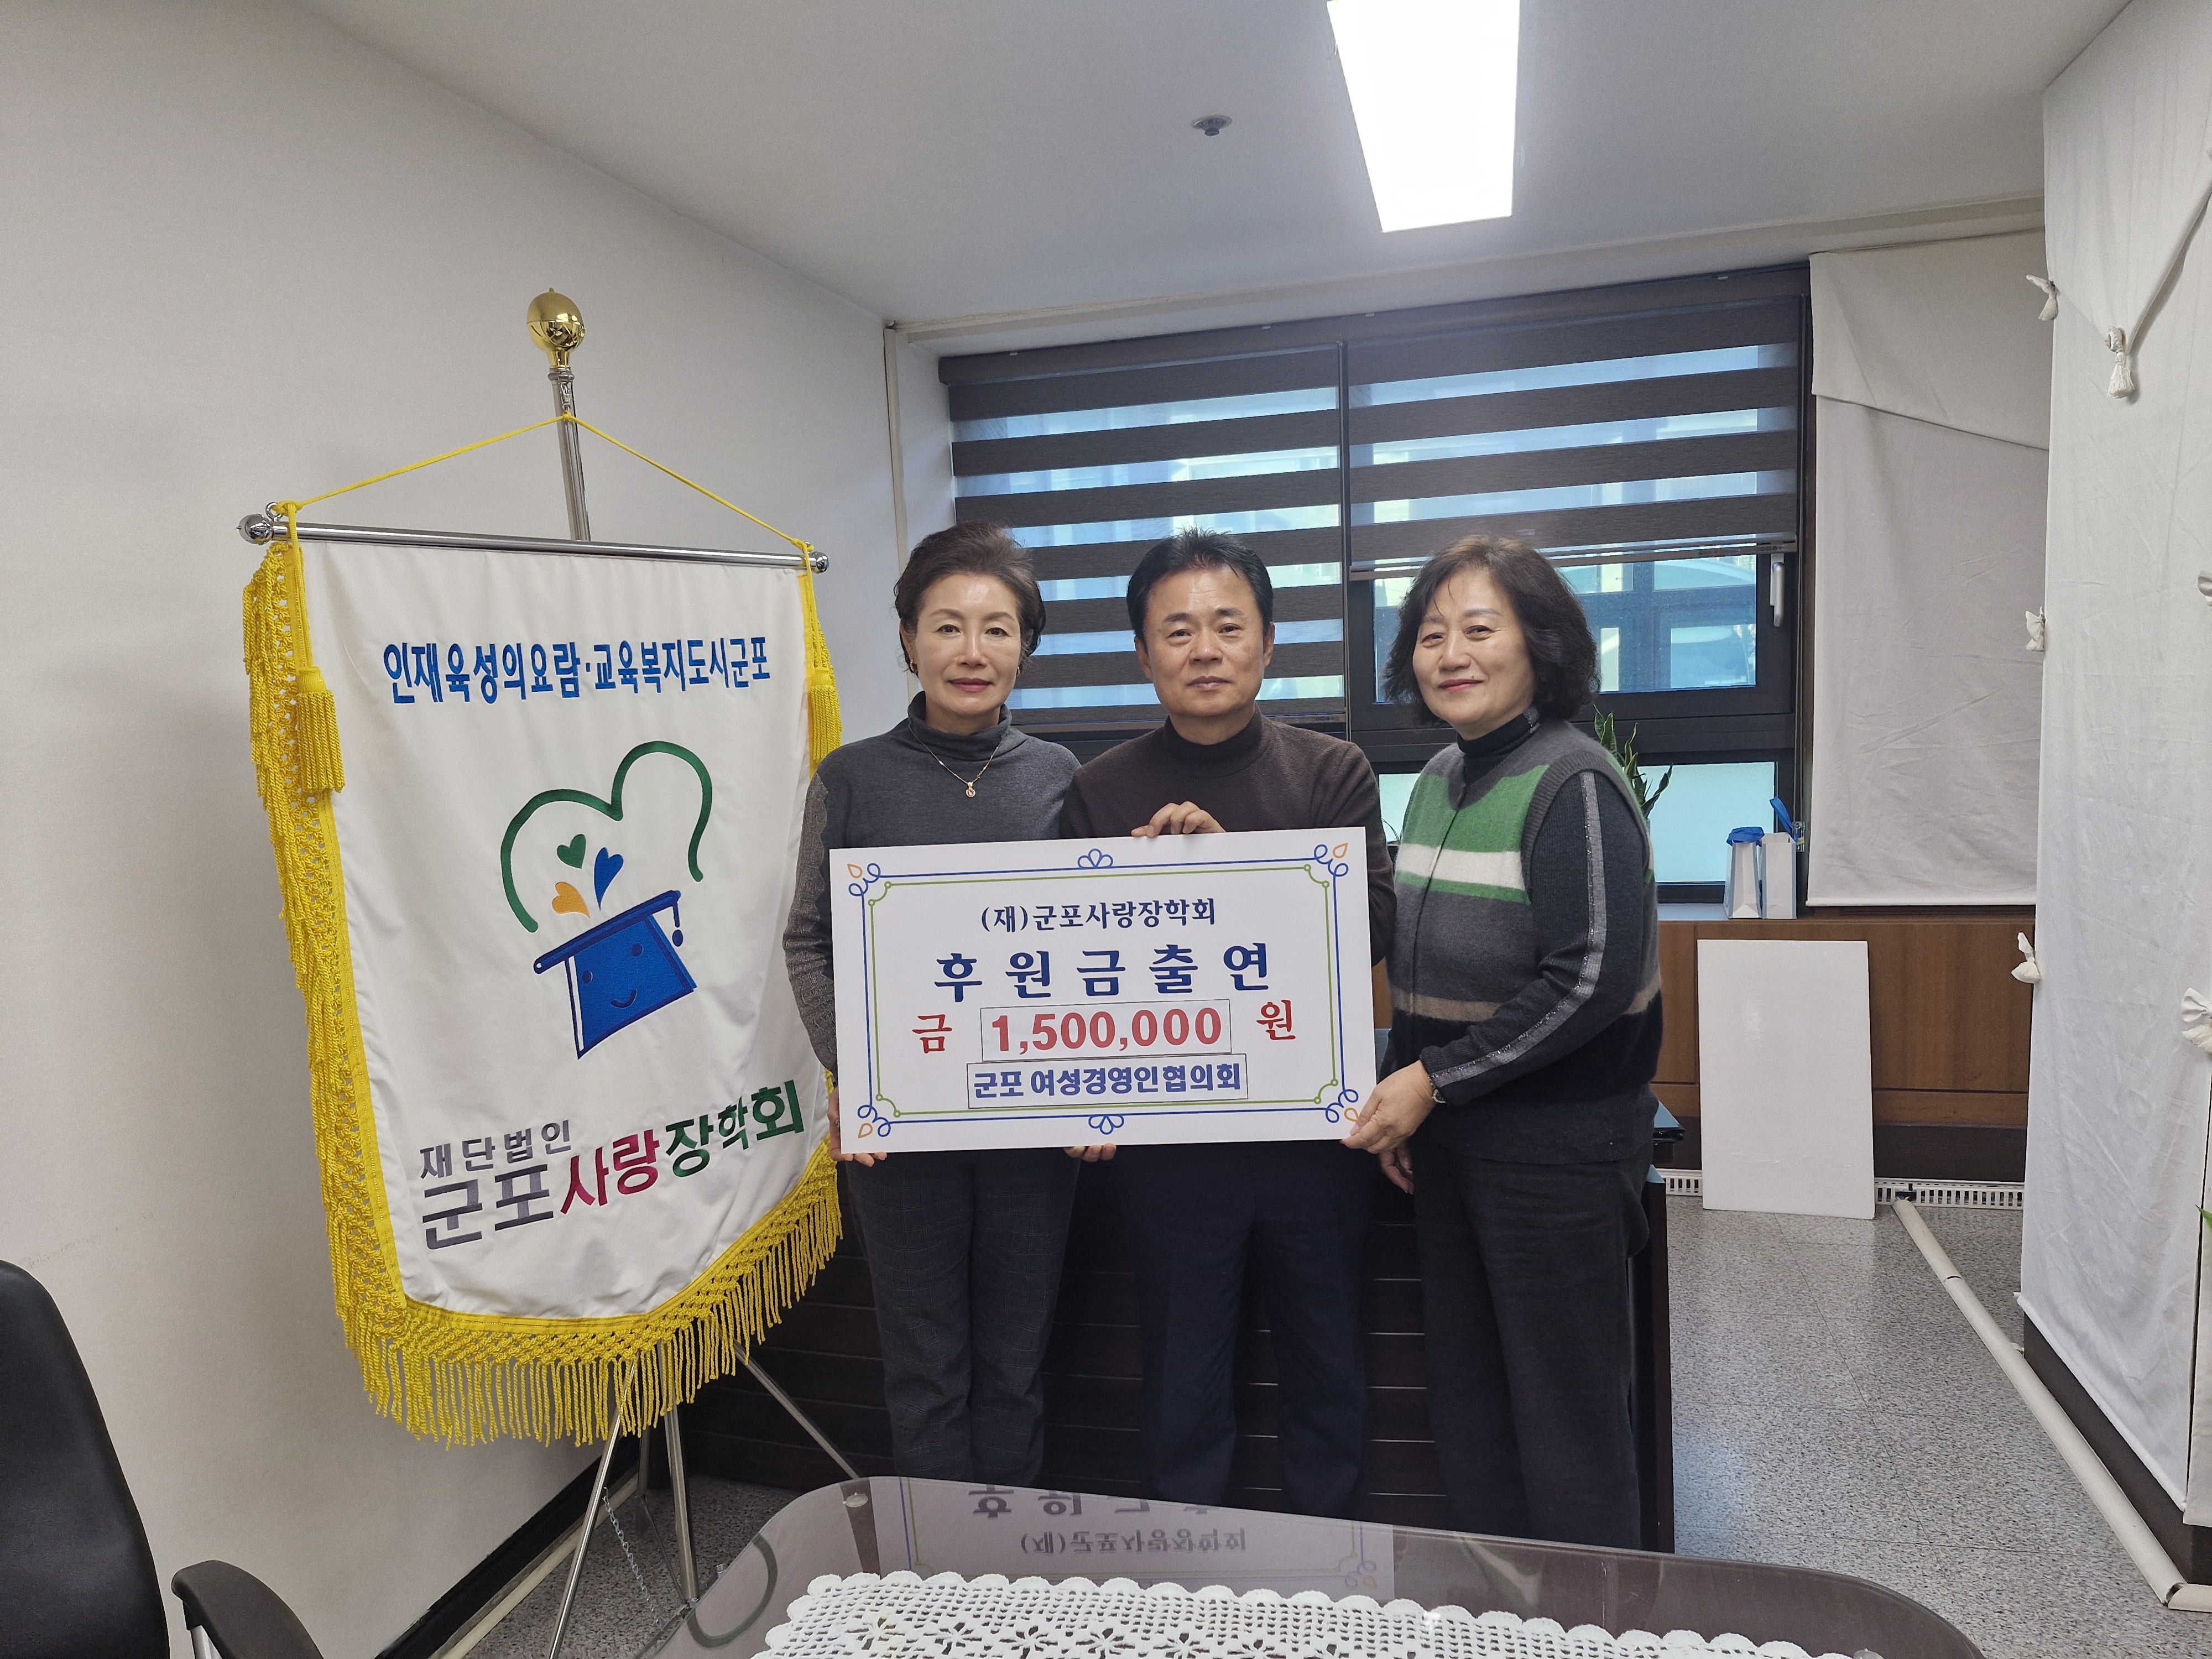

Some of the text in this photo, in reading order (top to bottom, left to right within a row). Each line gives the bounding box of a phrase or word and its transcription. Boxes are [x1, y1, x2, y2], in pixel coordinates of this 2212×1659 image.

[981, 898, 1217, 932] (재)군포사랑장학회
[912, 999, 1296, 1055] 금 1,500,000 원
[975, 1063, 1241, 1099] 군포 여성경영인협의회
[420, 1119, 572, 1180] 재단법인
